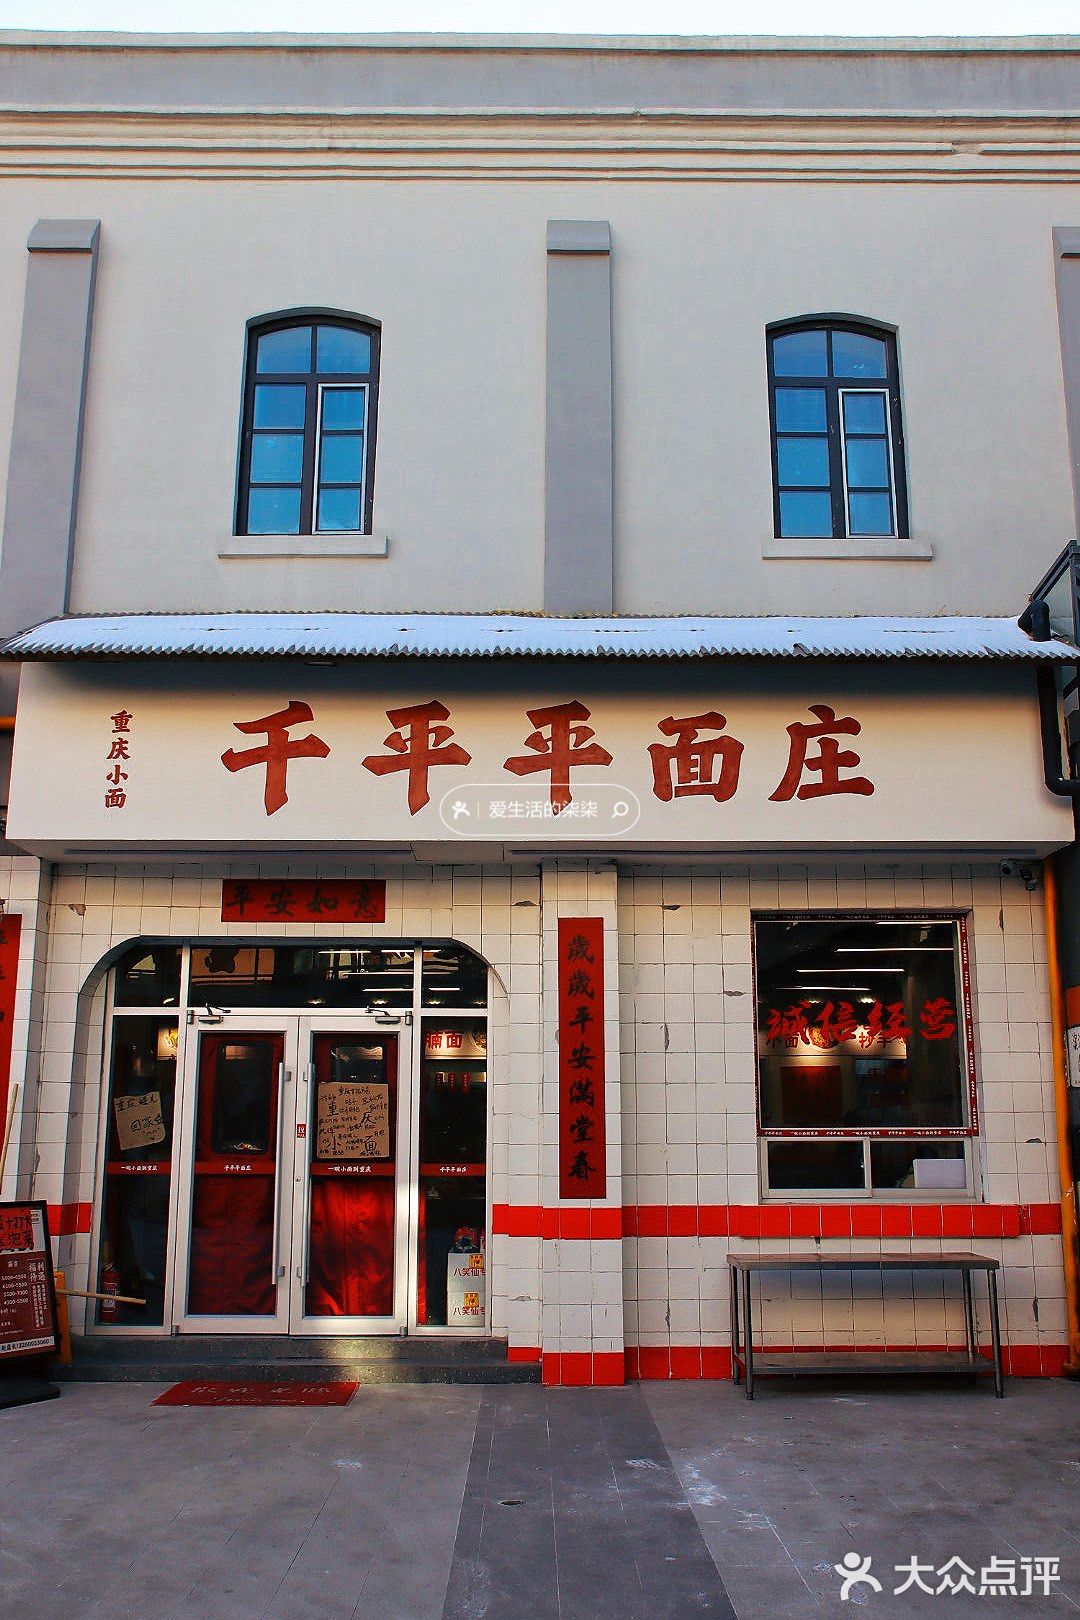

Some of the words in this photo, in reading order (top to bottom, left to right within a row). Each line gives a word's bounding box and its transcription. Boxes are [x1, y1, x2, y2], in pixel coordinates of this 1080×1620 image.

[104, 709, 134, 809] 重庆小面
[221, 699, 874, 816] 千平平面庄
[225, 882, 379, 920] 平安如意
